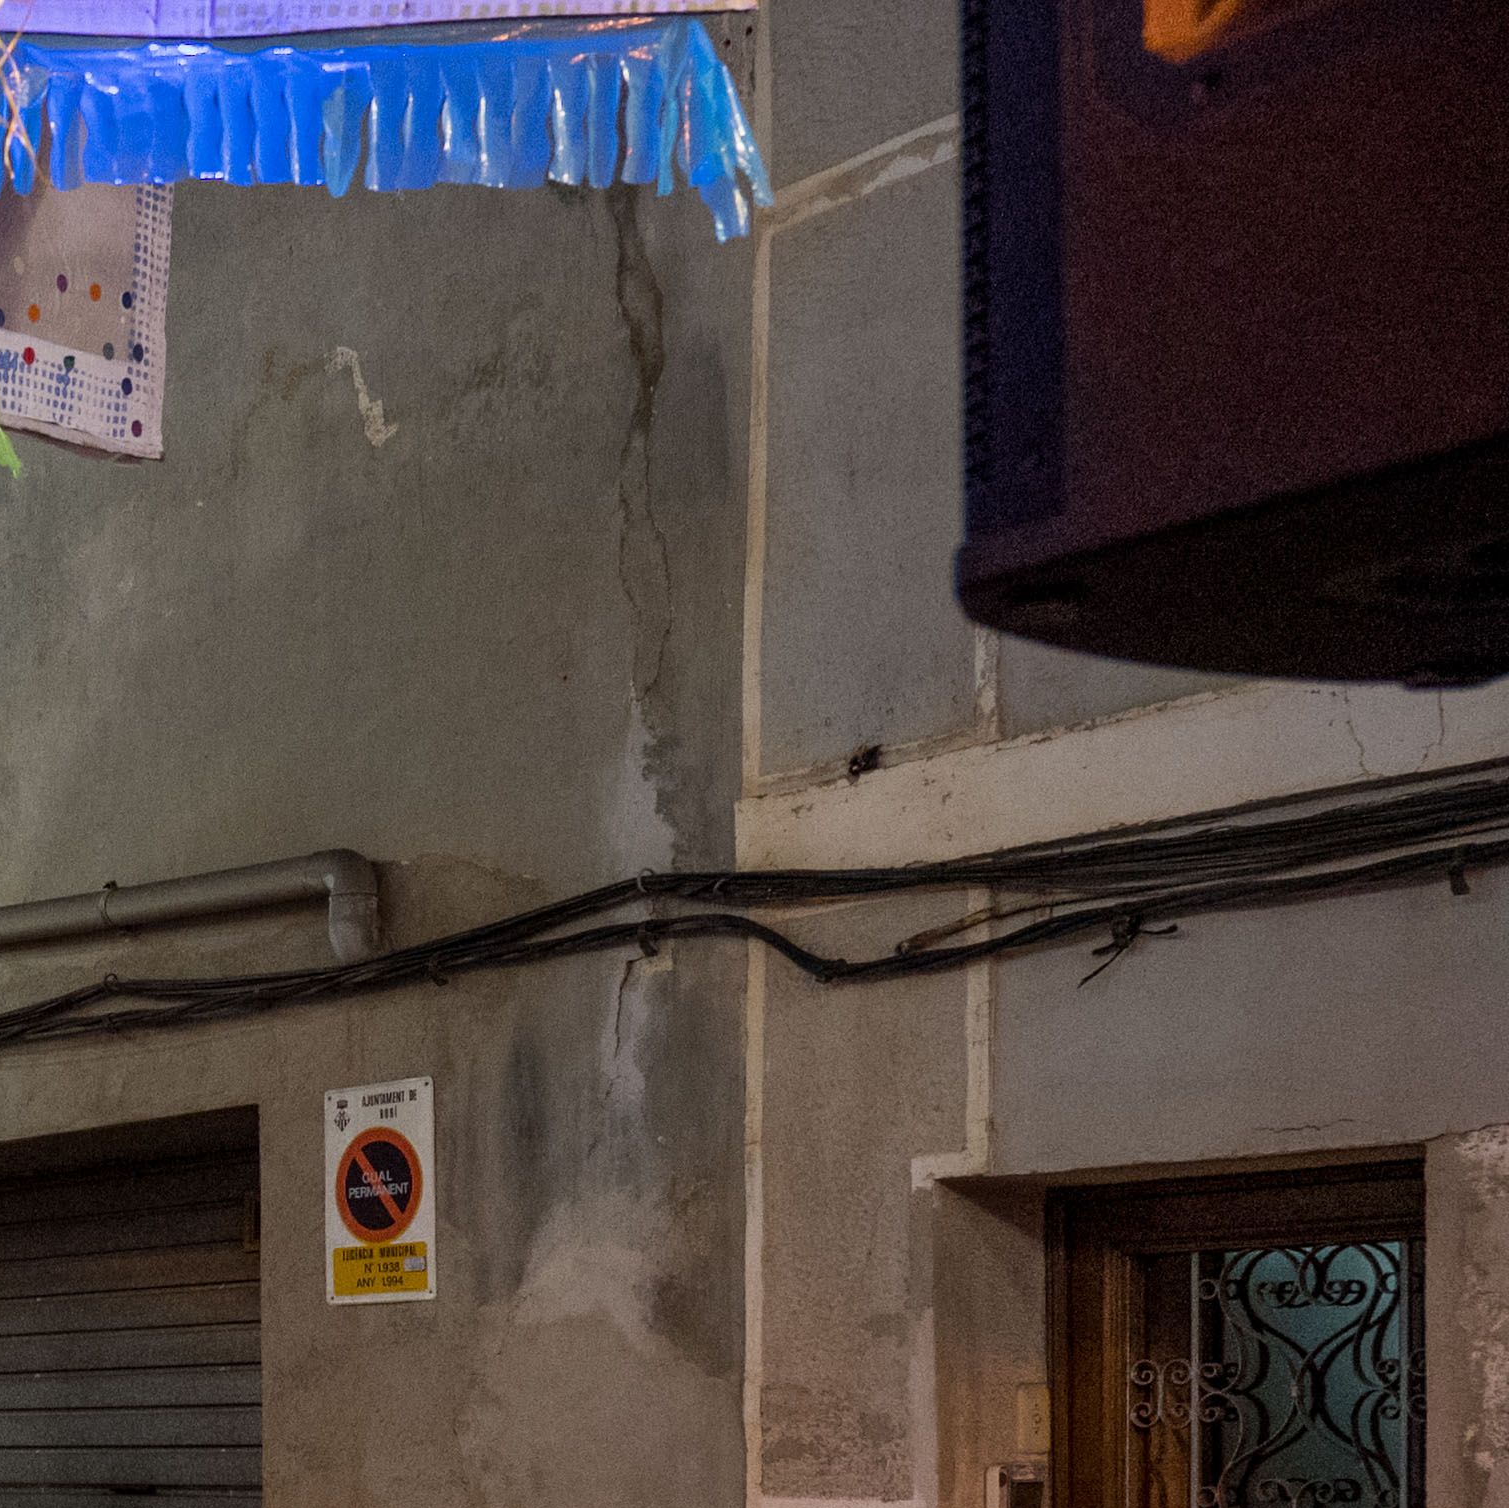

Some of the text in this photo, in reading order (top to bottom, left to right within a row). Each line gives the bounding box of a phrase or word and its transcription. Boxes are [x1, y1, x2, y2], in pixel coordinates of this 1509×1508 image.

[362, 1088, 418, 1107] AJUNTAMENT DE
[361, 1170, 393, 1184] GUAL
[348, 1182, 409, 1199] PERMANENT
[356, 1276, 377, 1288] ANY
